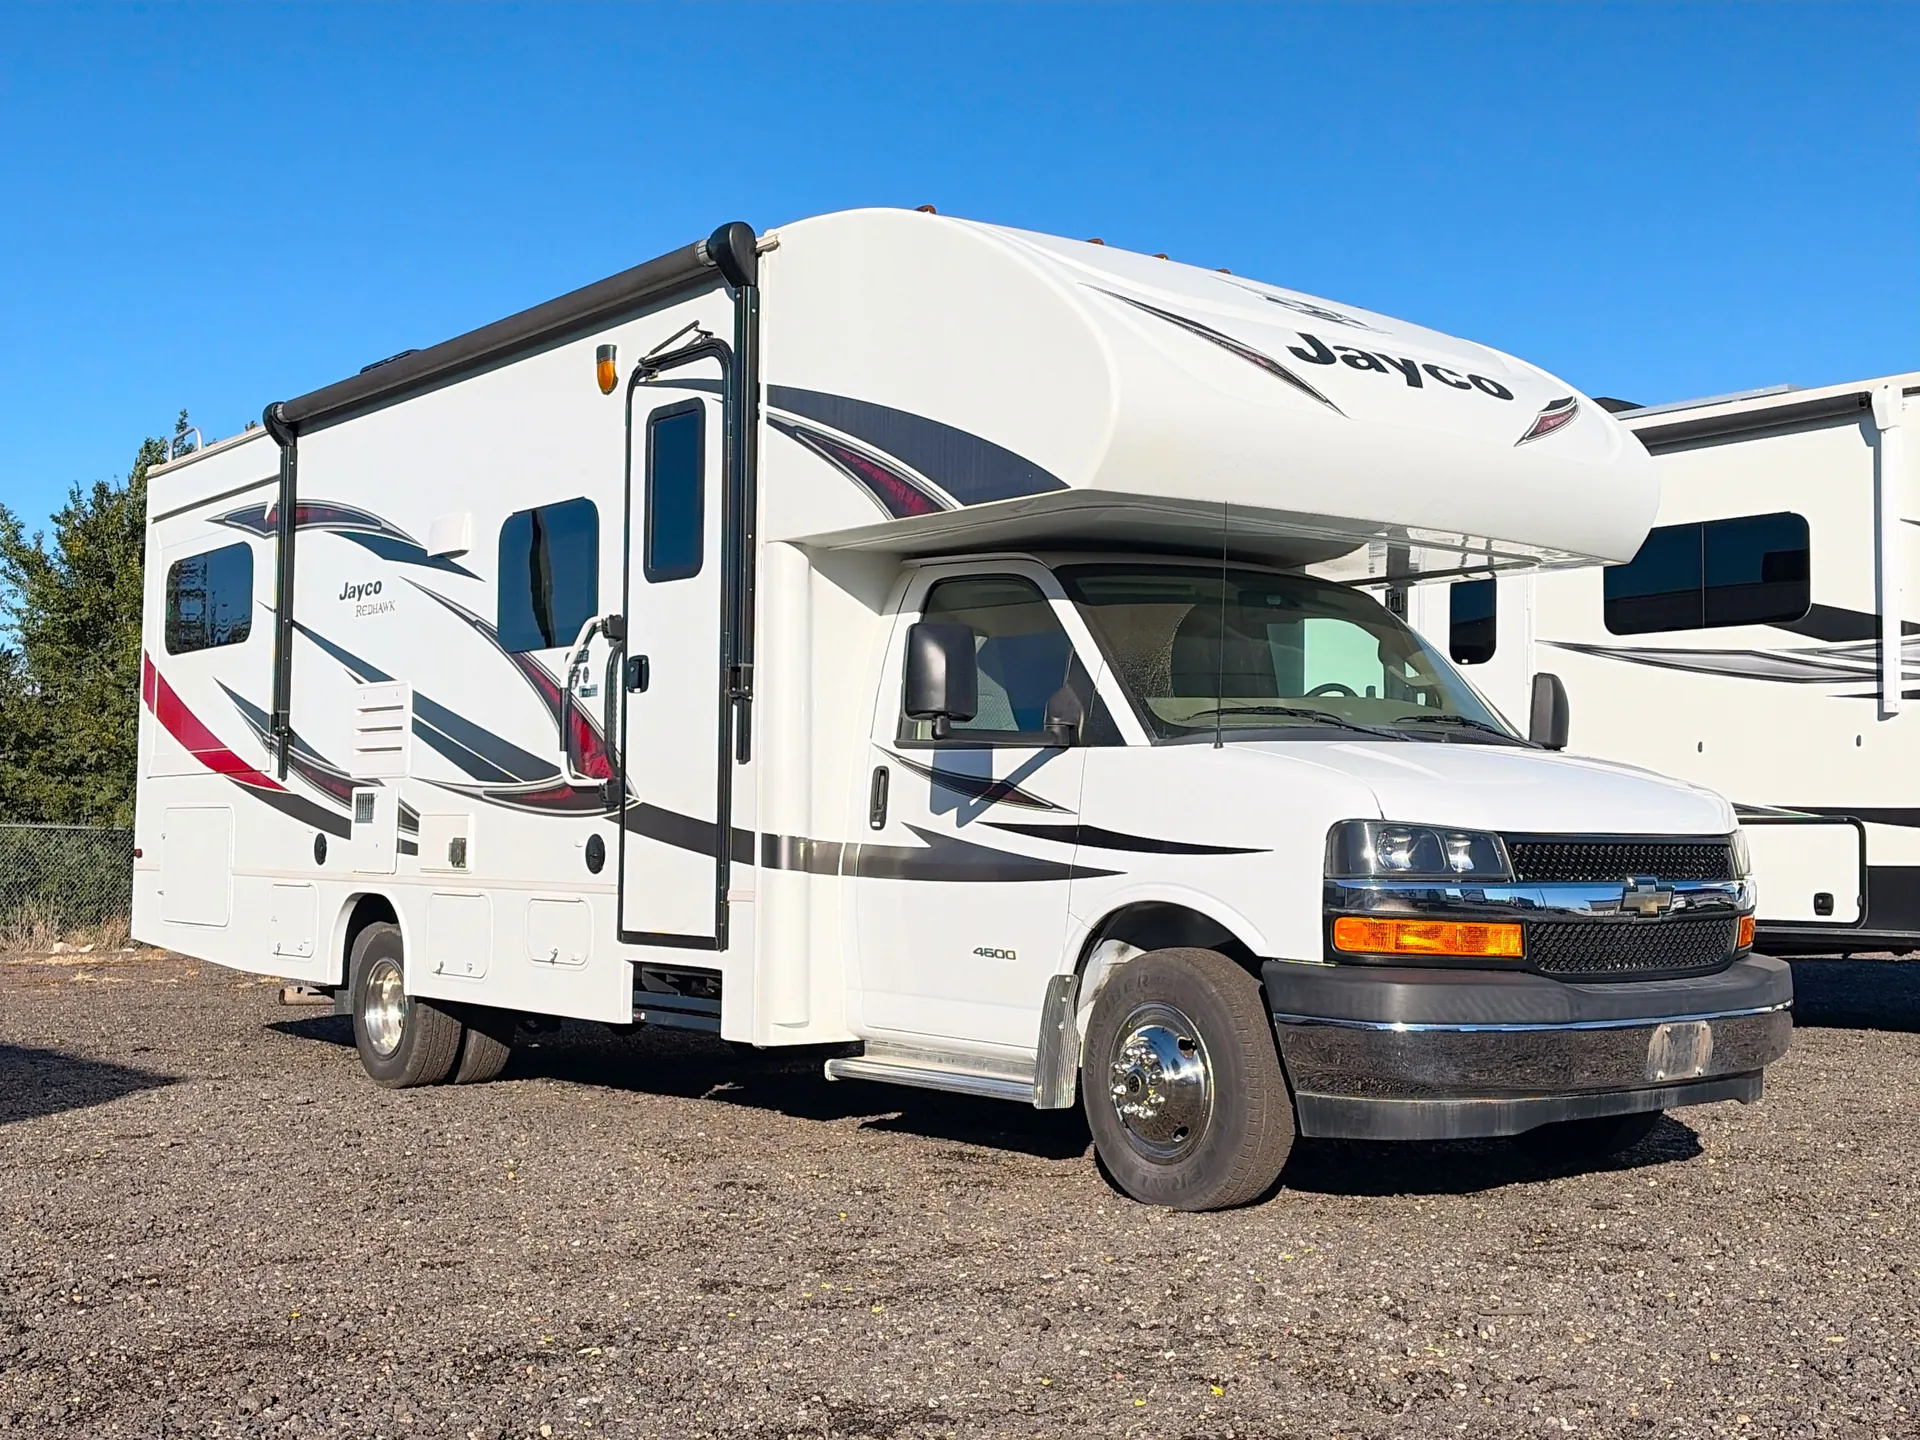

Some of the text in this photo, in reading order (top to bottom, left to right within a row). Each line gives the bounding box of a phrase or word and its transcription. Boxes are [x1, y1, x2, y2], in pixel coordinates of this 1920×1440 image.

[1286, 331, 1514, 400] Jayco
[339, 580, 383, 602] Jayco
[355, 600, 396, 618] REDHAWK
